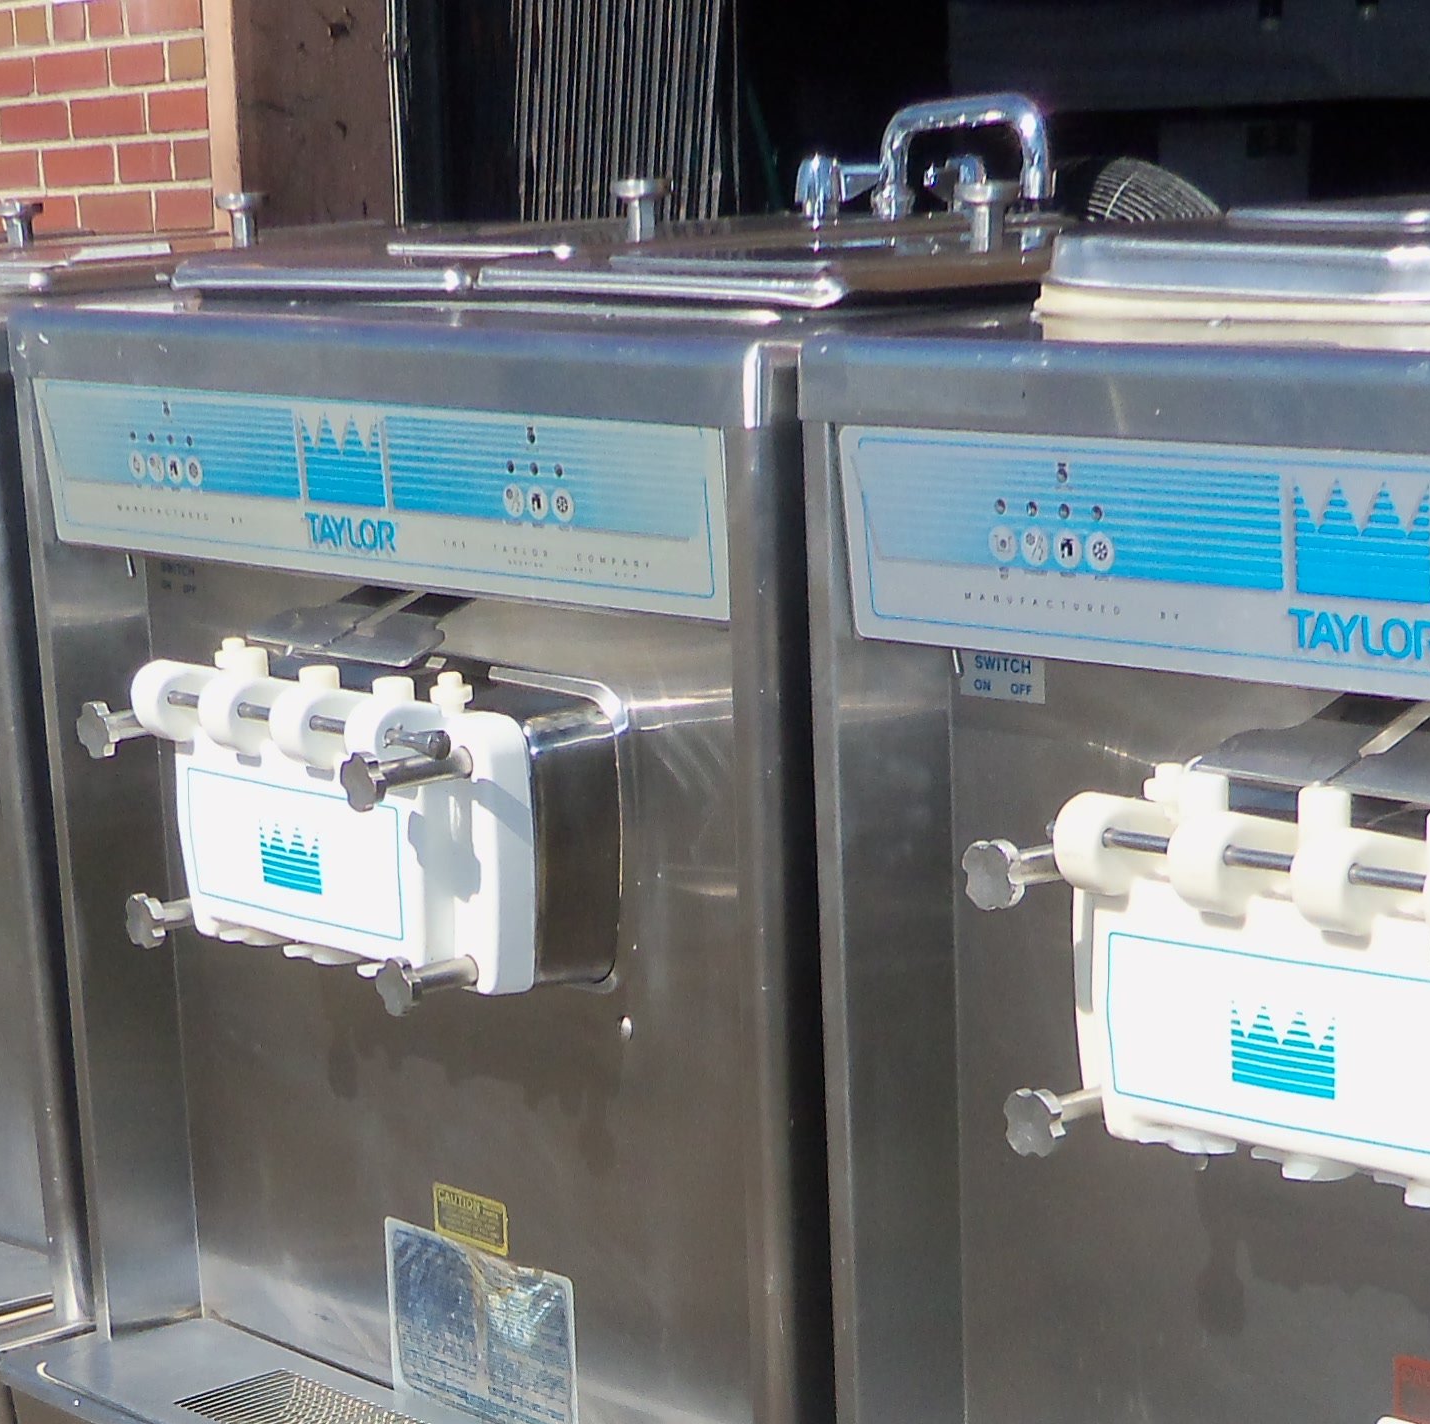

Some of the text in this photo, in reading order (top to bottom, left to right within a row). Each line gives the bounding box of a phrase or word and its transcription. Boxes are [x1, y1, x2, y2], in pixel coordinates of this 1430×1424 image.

[305, 512, 396, 552] TAYLOR
[964, 592, 1120, 616] MANUFACTURED
[974, 655, 1032, 675] SWITCH
[974, 679, 1032, 696] ON OFF
[438, 1189, 482, 1213] CAUTION
